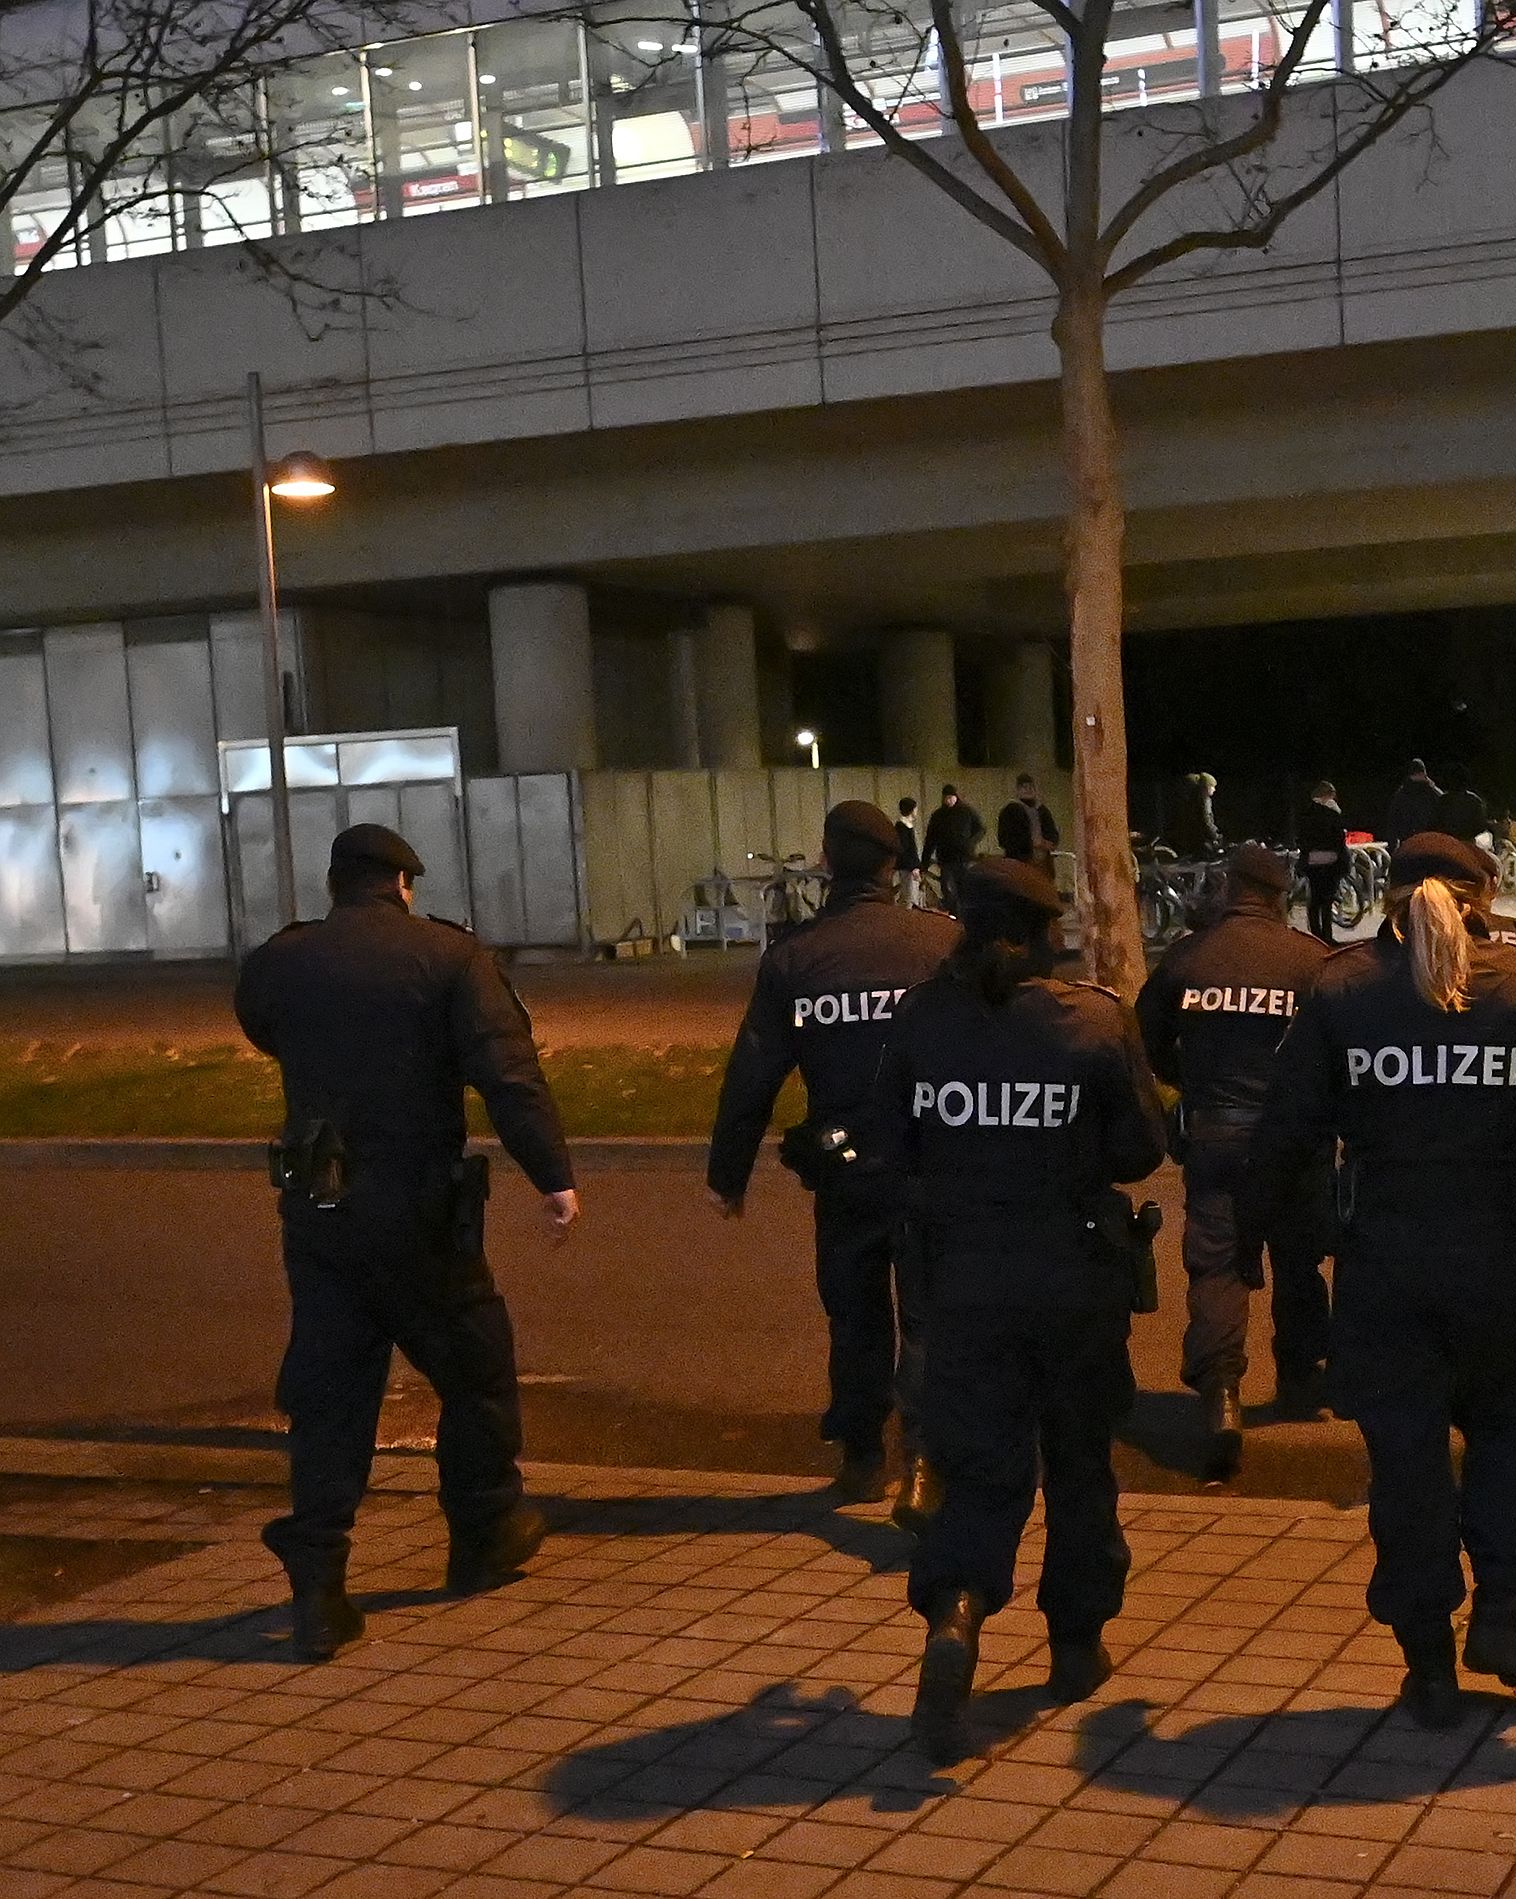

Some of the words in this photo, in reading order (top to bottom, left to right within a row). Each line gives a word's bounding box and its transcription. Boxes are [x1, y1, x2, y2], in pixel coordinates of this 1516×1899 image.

[794, 988, 907, 1027] POLIZ
[1181, 986, 1295, 1017] POLIZEI
[912, 1081, 1081, 1127] POLIZEI
